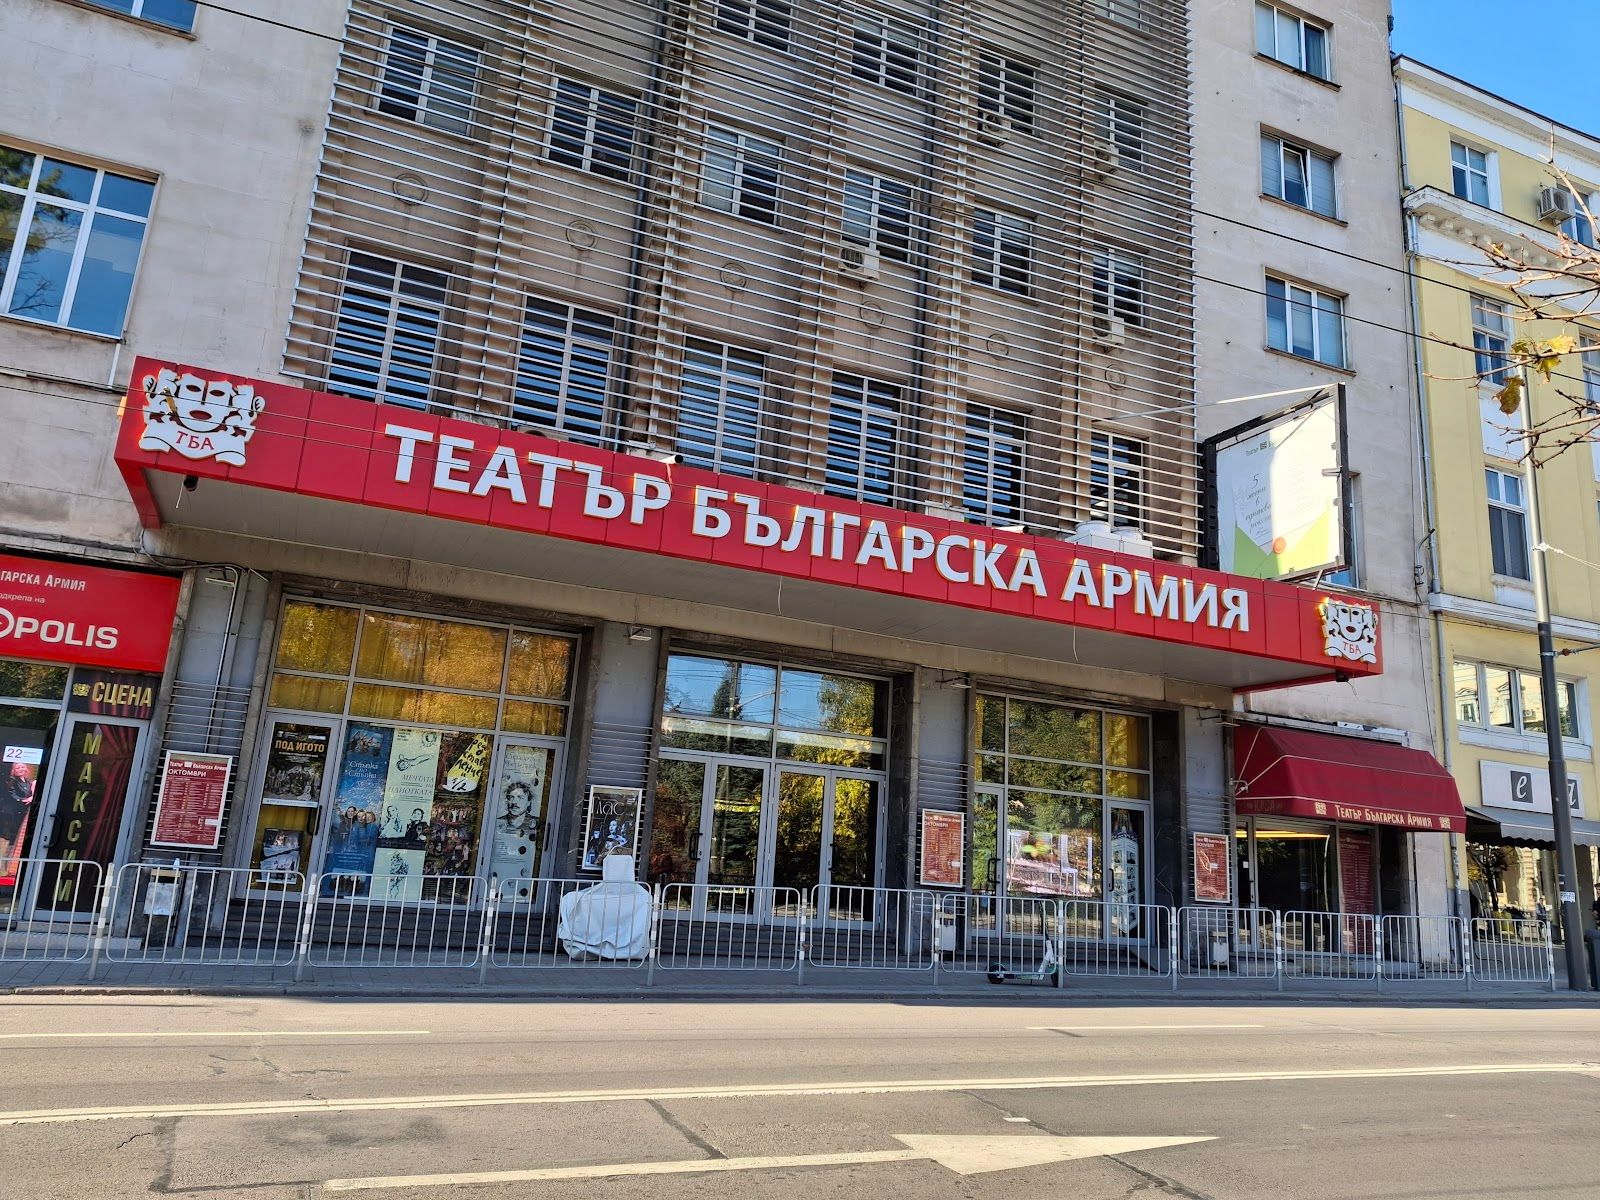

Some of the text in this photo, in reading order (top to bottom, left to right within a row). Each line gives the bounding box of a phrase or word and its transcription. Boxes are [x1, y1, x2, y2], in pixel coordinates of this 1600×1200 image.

[176, 431, 215, 450] ТБА
[385, 423, 1250, 632] ТЕАТЪР БЪЛГАРСКА АРМИЯ
[1342, 641, 1361, 655] ТБА
[92, 681, 152, 707] СЦЕНА
[7, 748, 23, 759] 22
[275, 740, 325, 753] ПОД ИГОТО
[168, 768, 206, 778] ОКТОМВРИ
